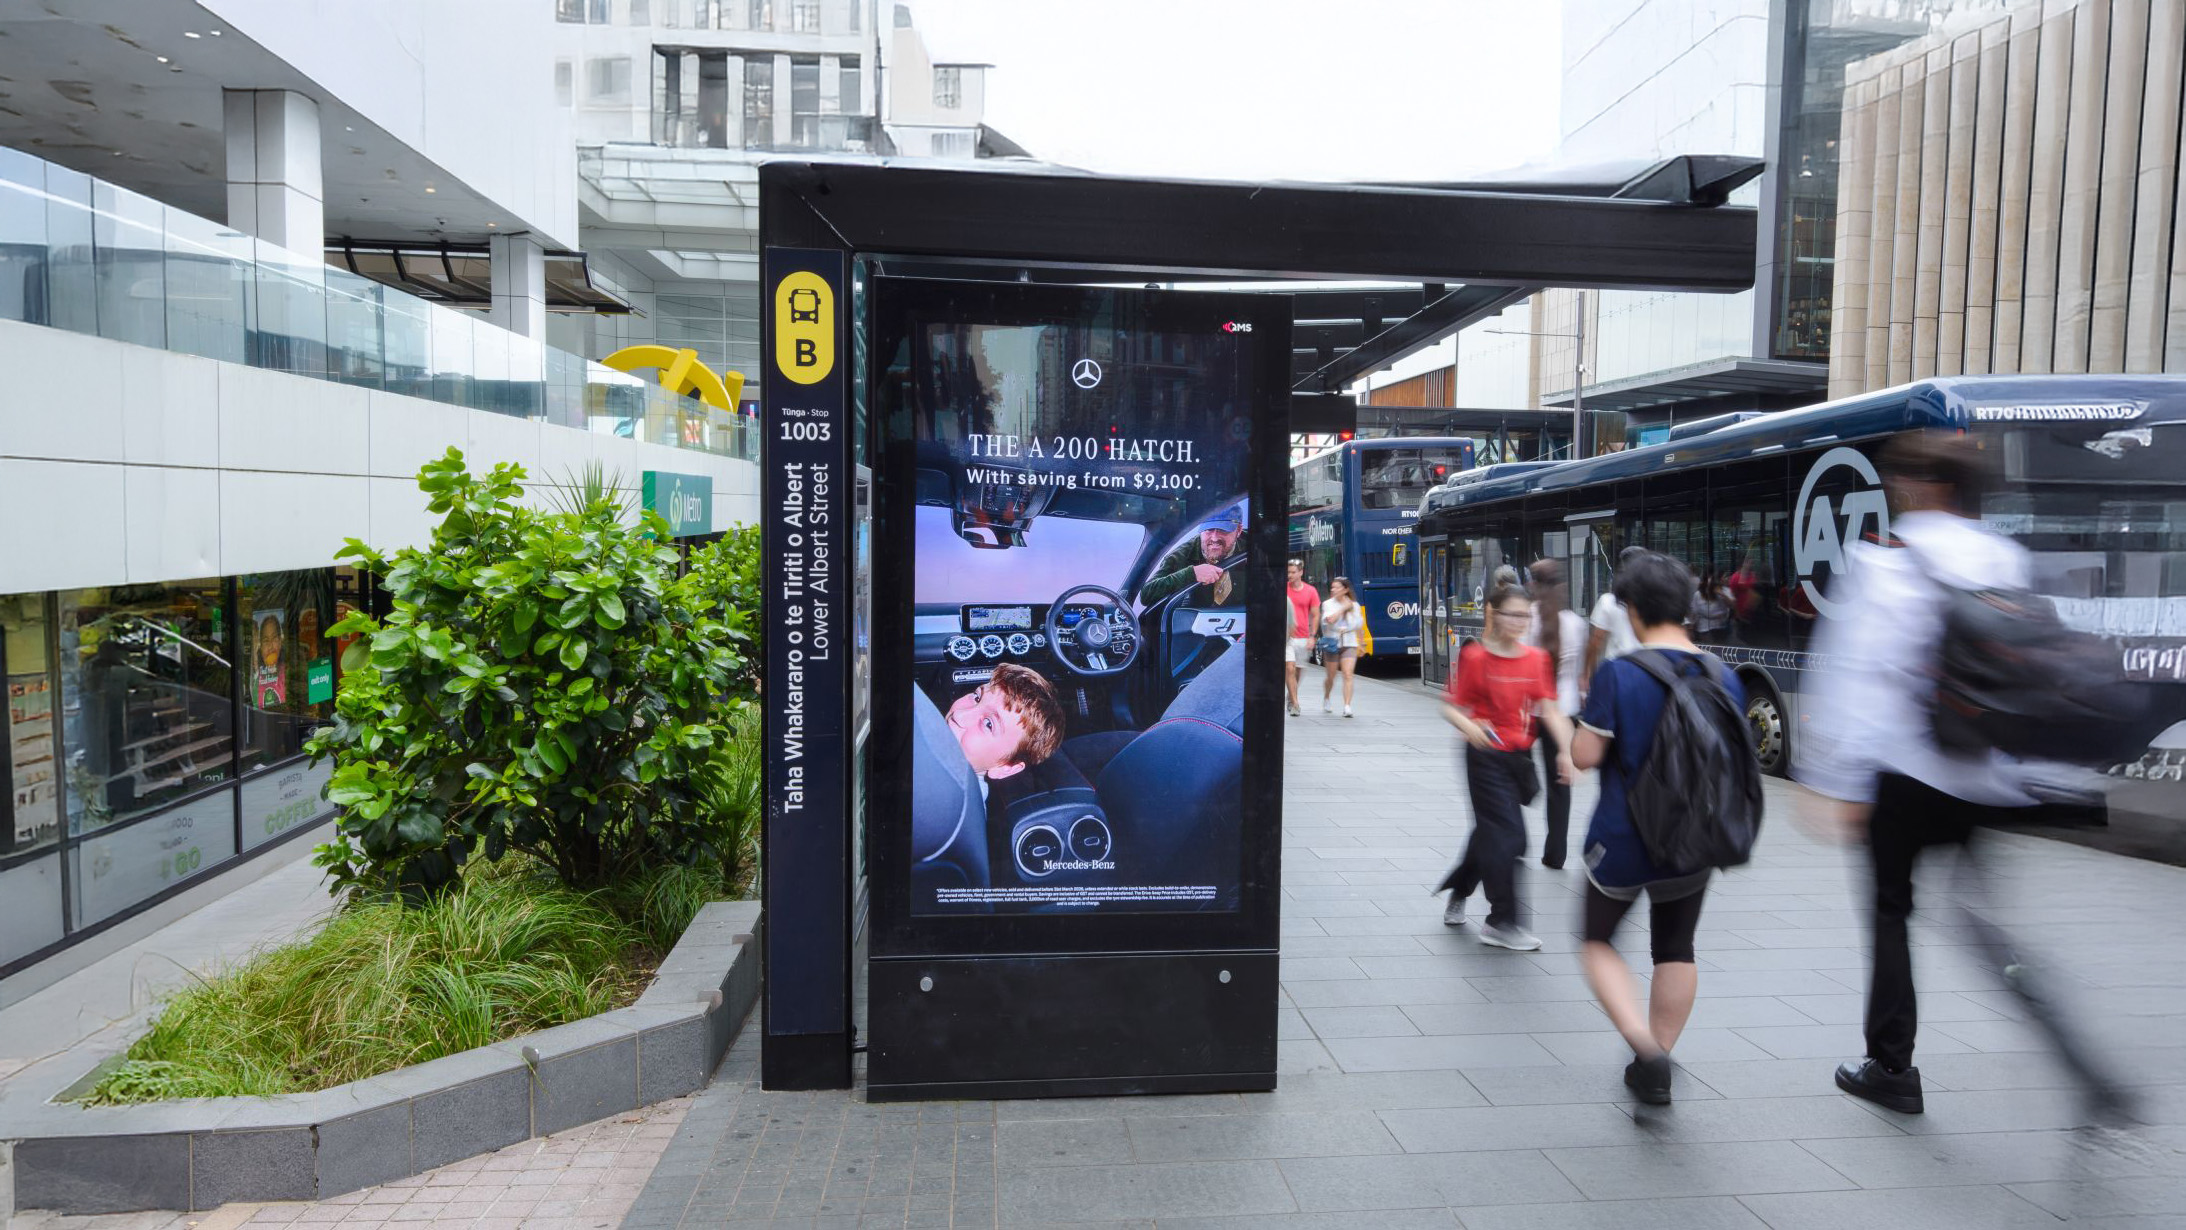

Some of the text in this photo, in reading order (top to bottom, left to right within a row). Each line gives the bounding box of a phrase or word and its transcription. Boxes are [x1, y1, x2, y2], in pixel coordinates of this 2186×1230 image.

[795, 339, 818, 367] B
[811, 408, 829, 418] Stop
[781, 421, 831, 441] 1003
[968, 433, 1200, 463] THE A 200 HATCH.
[966, 468, 1010, 485] With
[1018, 471, 1077, 490] saving
[1083, 471, 1126, 488] from
[683, 491, 702, 523] Metro
[1315, 519, 1334, 542] Metro
[810, 463, 829, 660] Lower Albert Street
[784, 462, 803, 813] Taha Whakararo o te Tiriti o Albert
[1043, 859, 1115, 870] Mercedes-Benz
